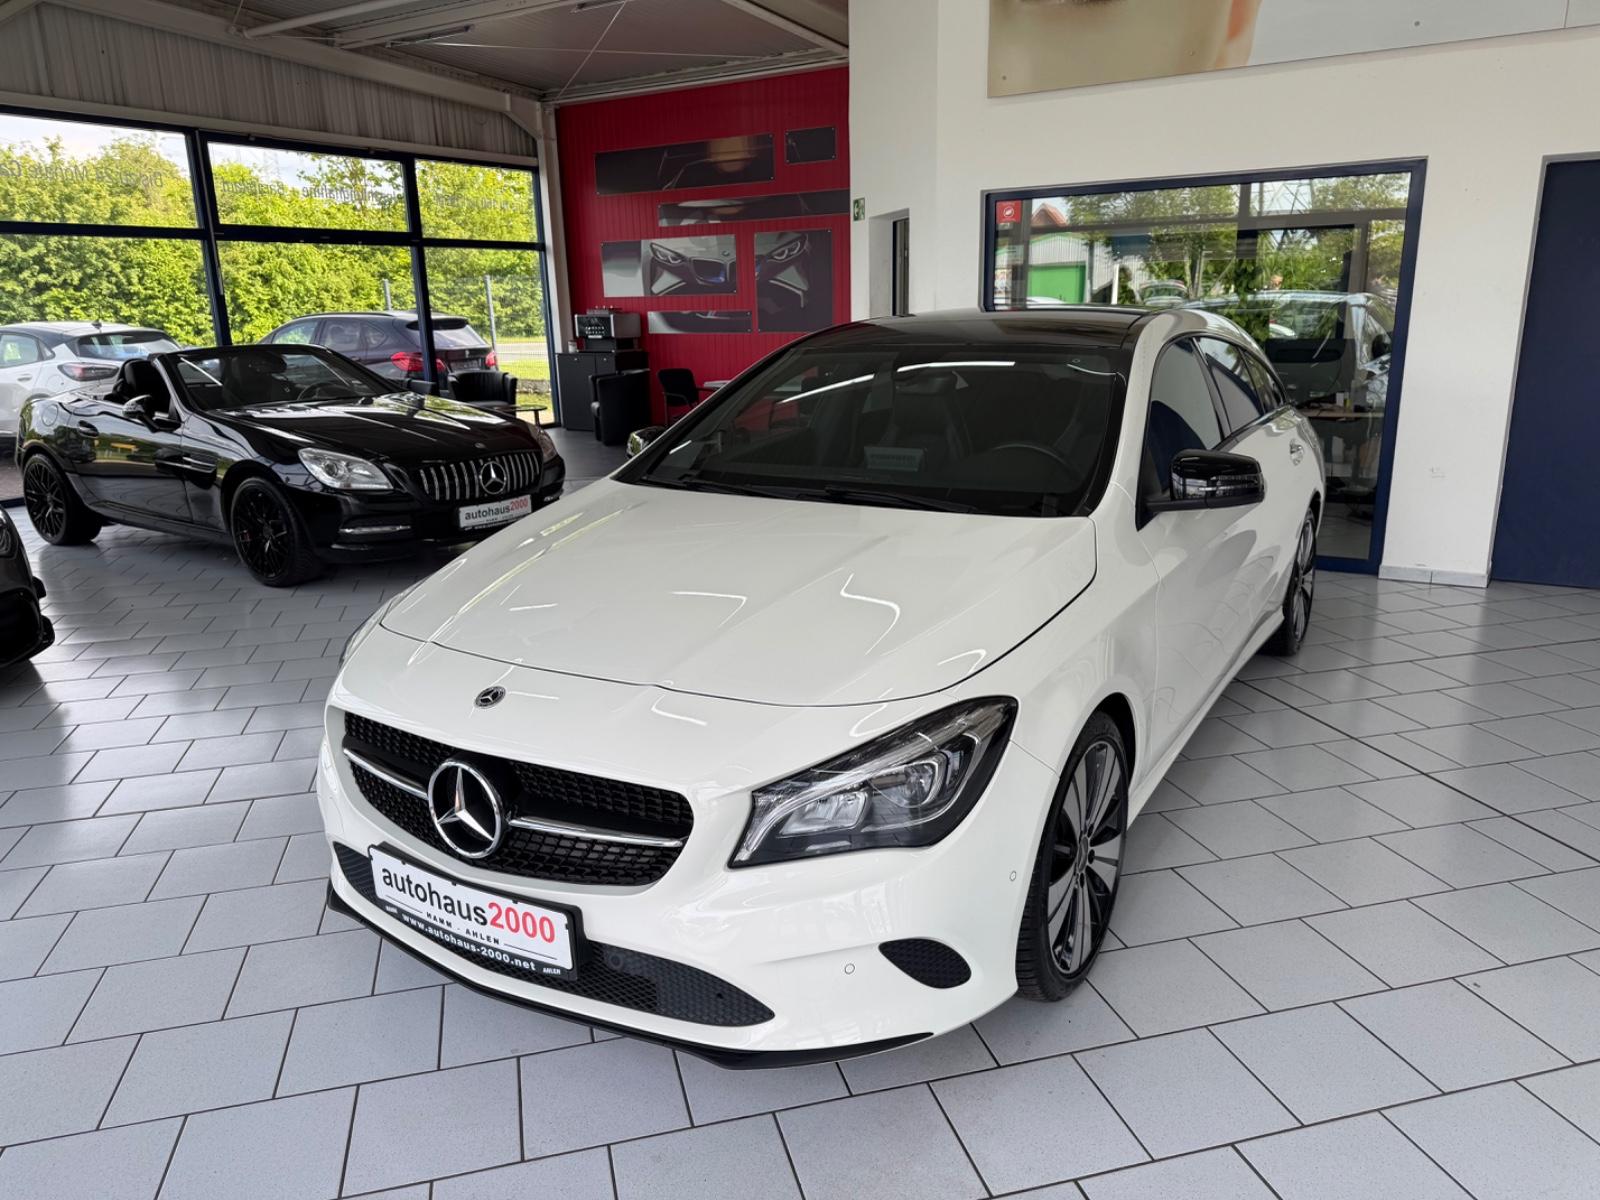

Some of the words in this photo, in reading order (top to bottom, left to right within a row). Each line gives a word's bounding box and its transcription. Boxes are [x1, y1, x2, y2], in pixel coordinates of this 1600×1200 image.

[465, 498, 528, 520] autohaus2000
[381, 868, 556, 944] autohaus2000
[426, 911, 452, 928] HAMM
[465, 928, 500, 945] AHLEN
[401, 914, 537, 971] www.autohaus-2000.net
